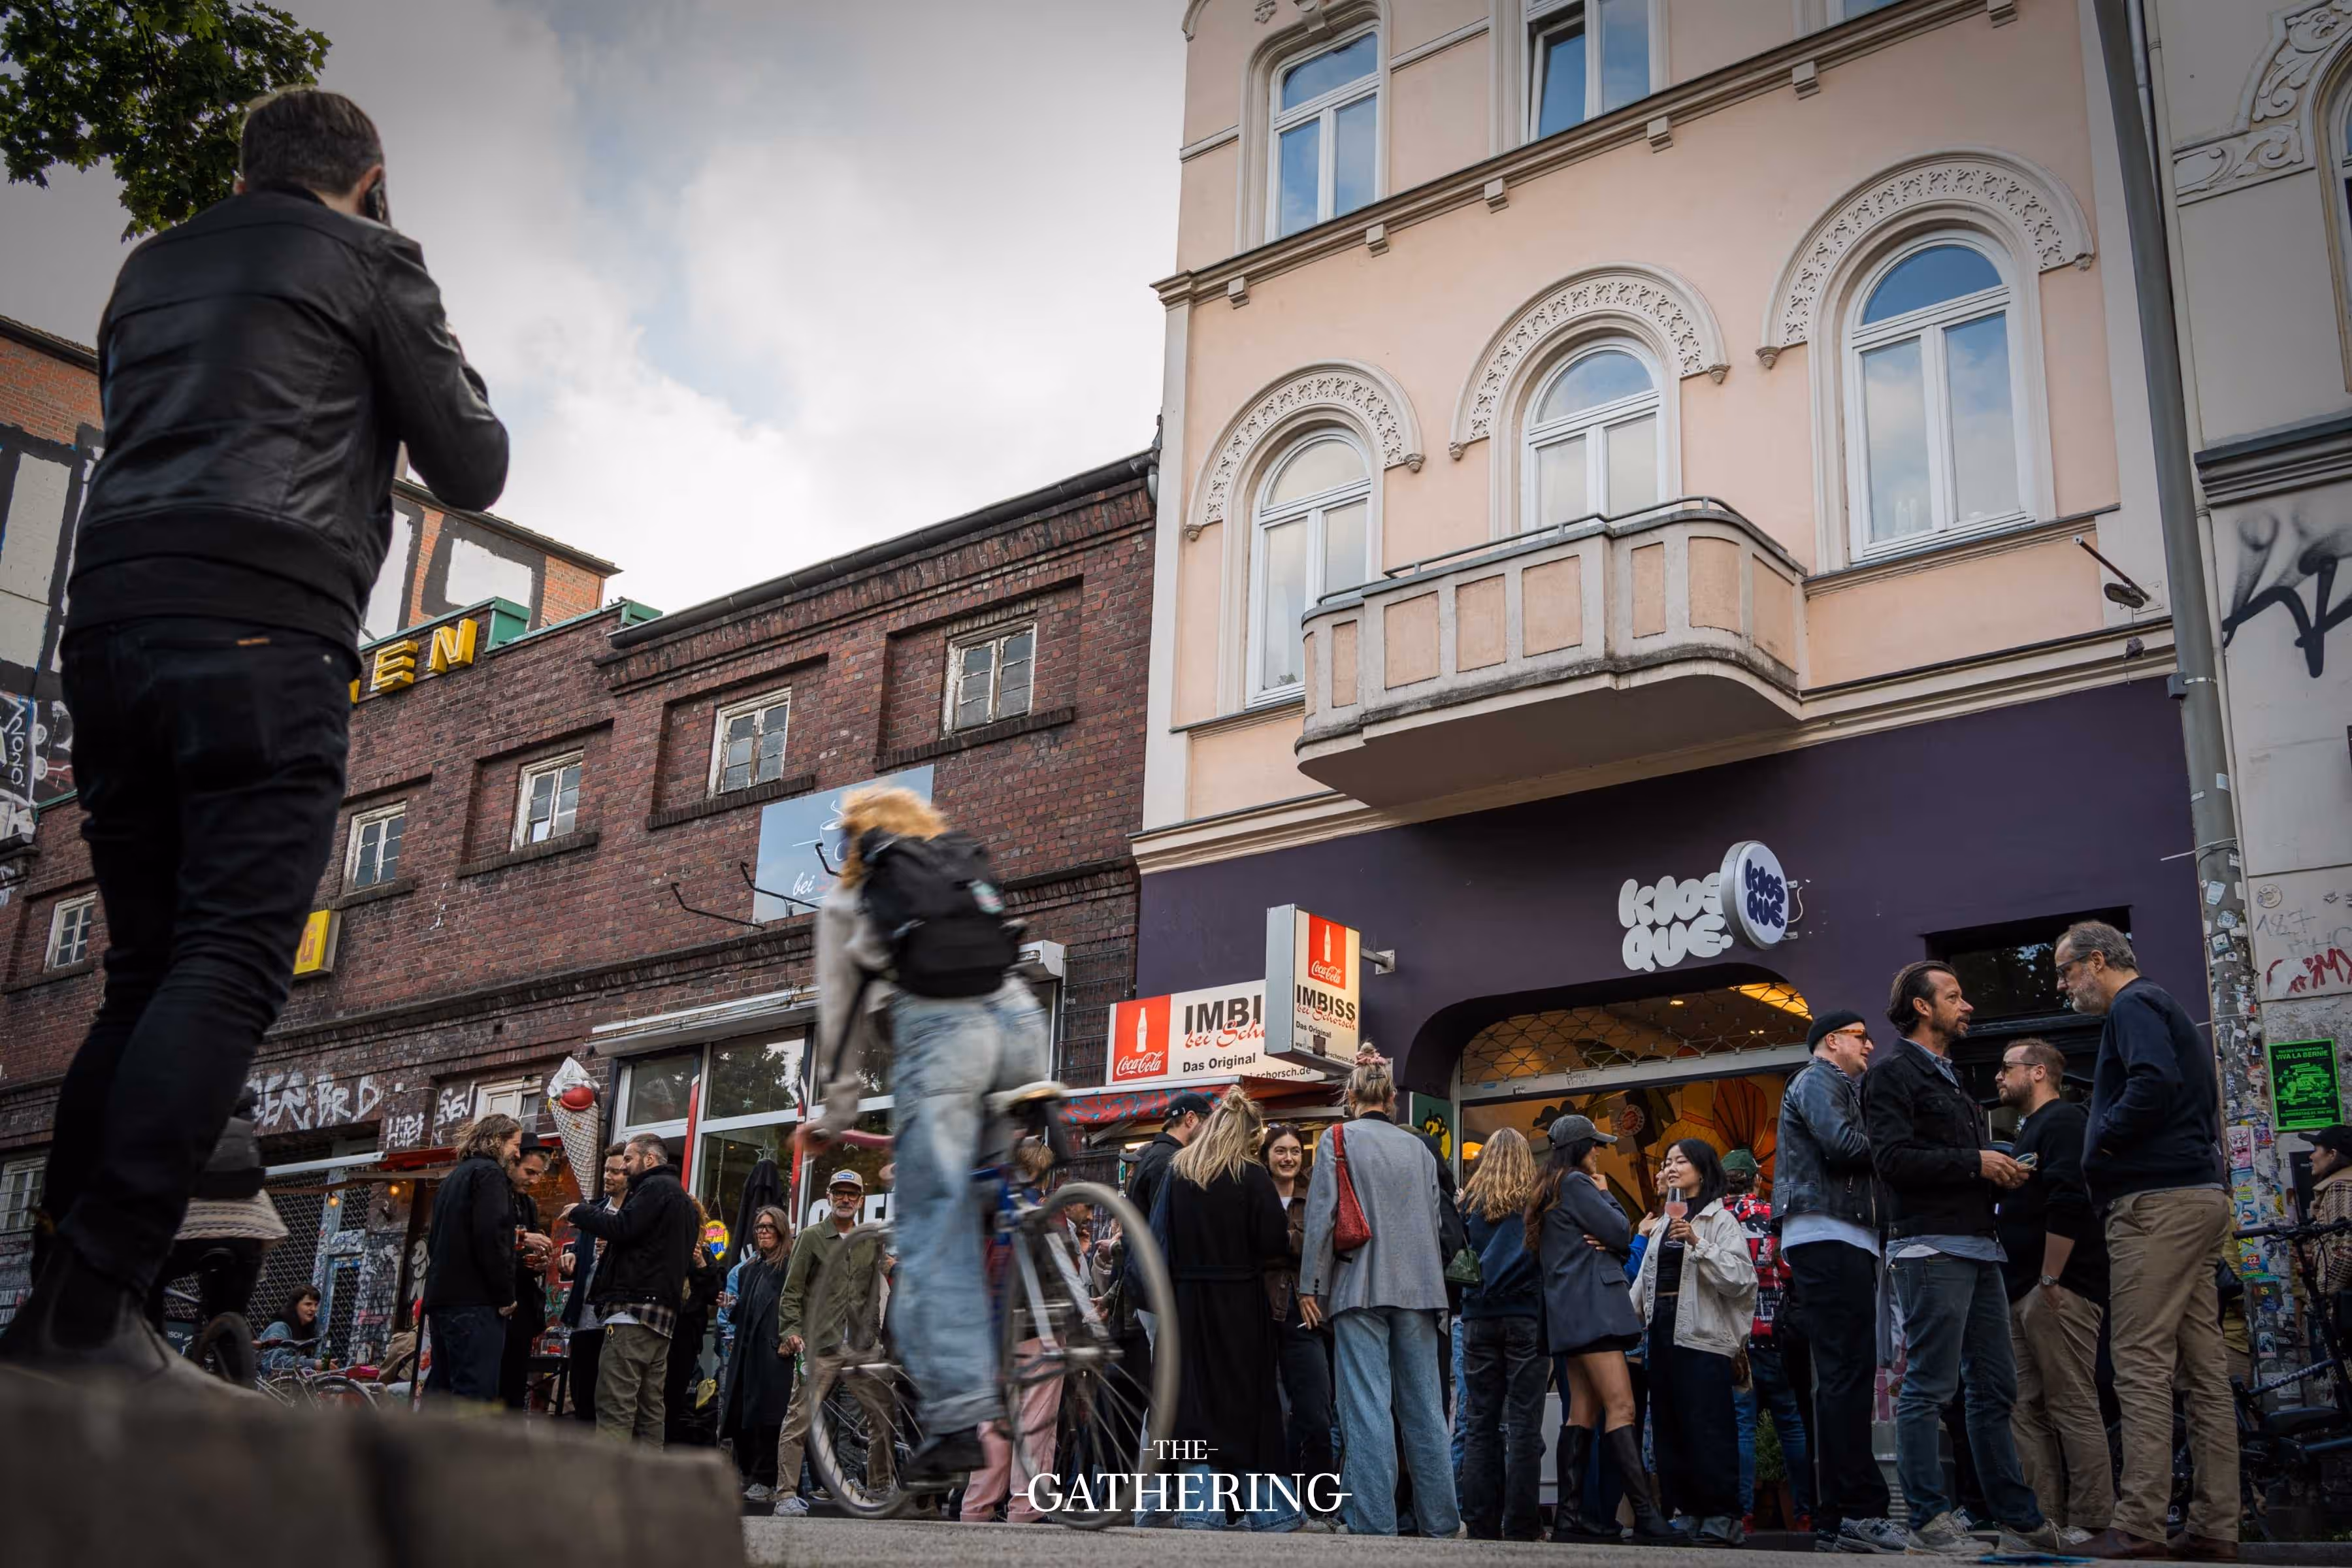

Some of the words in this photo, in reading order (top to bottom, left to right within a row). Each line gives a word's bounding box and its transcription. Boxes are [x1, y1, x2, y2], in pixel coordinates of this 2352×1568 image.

[792, 872, 815, 896] bei
[1311, 960, 1343, 985] Coca-Cola
[1296, 984, 1356, 1021] IMBISS
[1297, 1003, 1309, 1015] bei
[1313, 1004, 1356, 1030] Schorsch
[1184, 1030, 1211, 1049] bei
[1296, 1021, 1307, 1031] Das
[1308, 1024, 1331, 1039] Original
[1116, 1051, 1165, 1077] Coca-Cola
[1183, 1062, 1205, 1073] Das
[1209, 1052, 1256, 1070] Original
